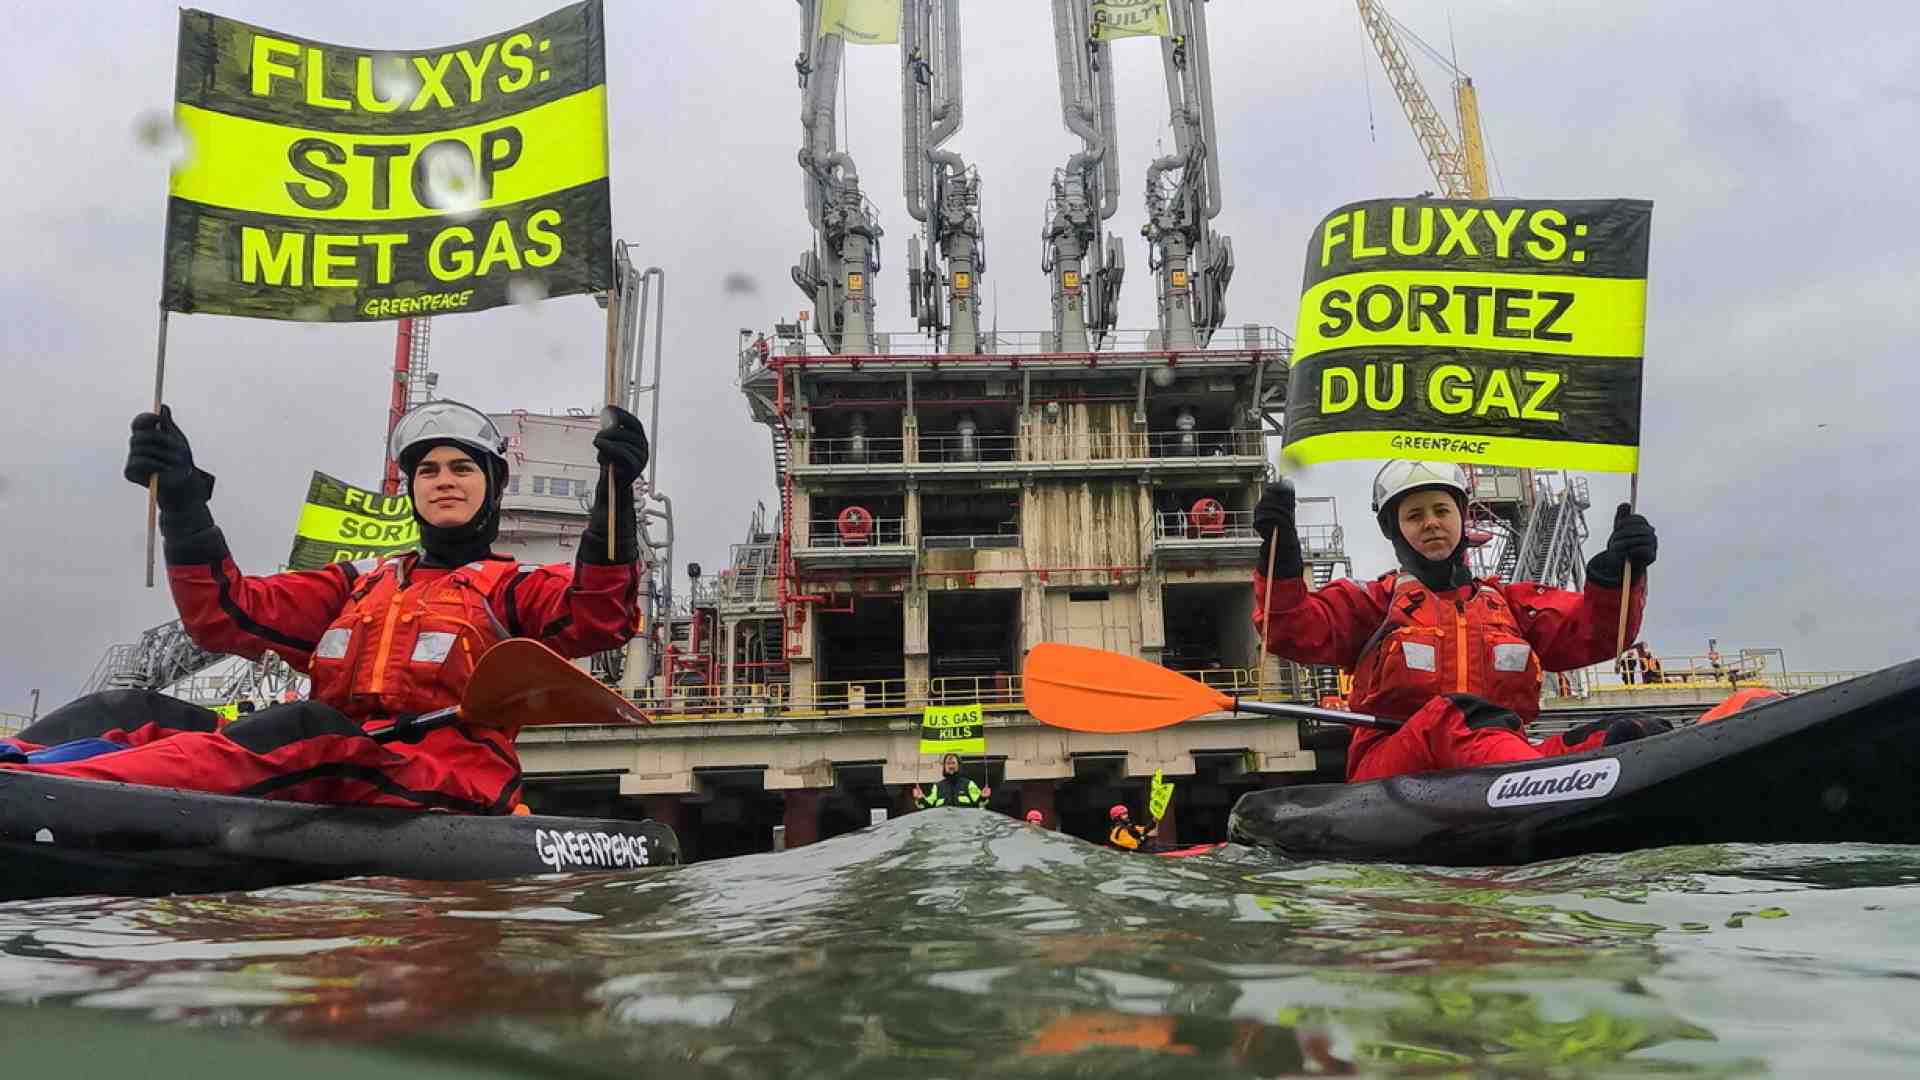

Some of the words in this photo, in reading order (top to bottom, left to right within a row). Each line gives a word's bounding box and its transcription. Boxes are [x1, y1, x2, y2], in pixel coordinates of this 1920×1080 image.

[251, 33, 550, 113] FLUXYS:
[284, 125, 523, 211] STOP
[242, 227, 408, 287] MET
[428, 209, 563, 282] GAS
[1321, 207, 1588, 267] FLUXYS:
[364, 289, 474, 316] GREENPEACE
[1318, 285, 1576, 342] SORTEZ
[1321, 363, 1405, 415] DU
[1428, 364, 1561, 421] GAZ
[1391, 435, 1490, 454] GREENPEACE
[953, 710, 977, 725] GAS
[1496, 769, 1609, 801] islander
[535, 829, 649, 872] GREENPEACE
